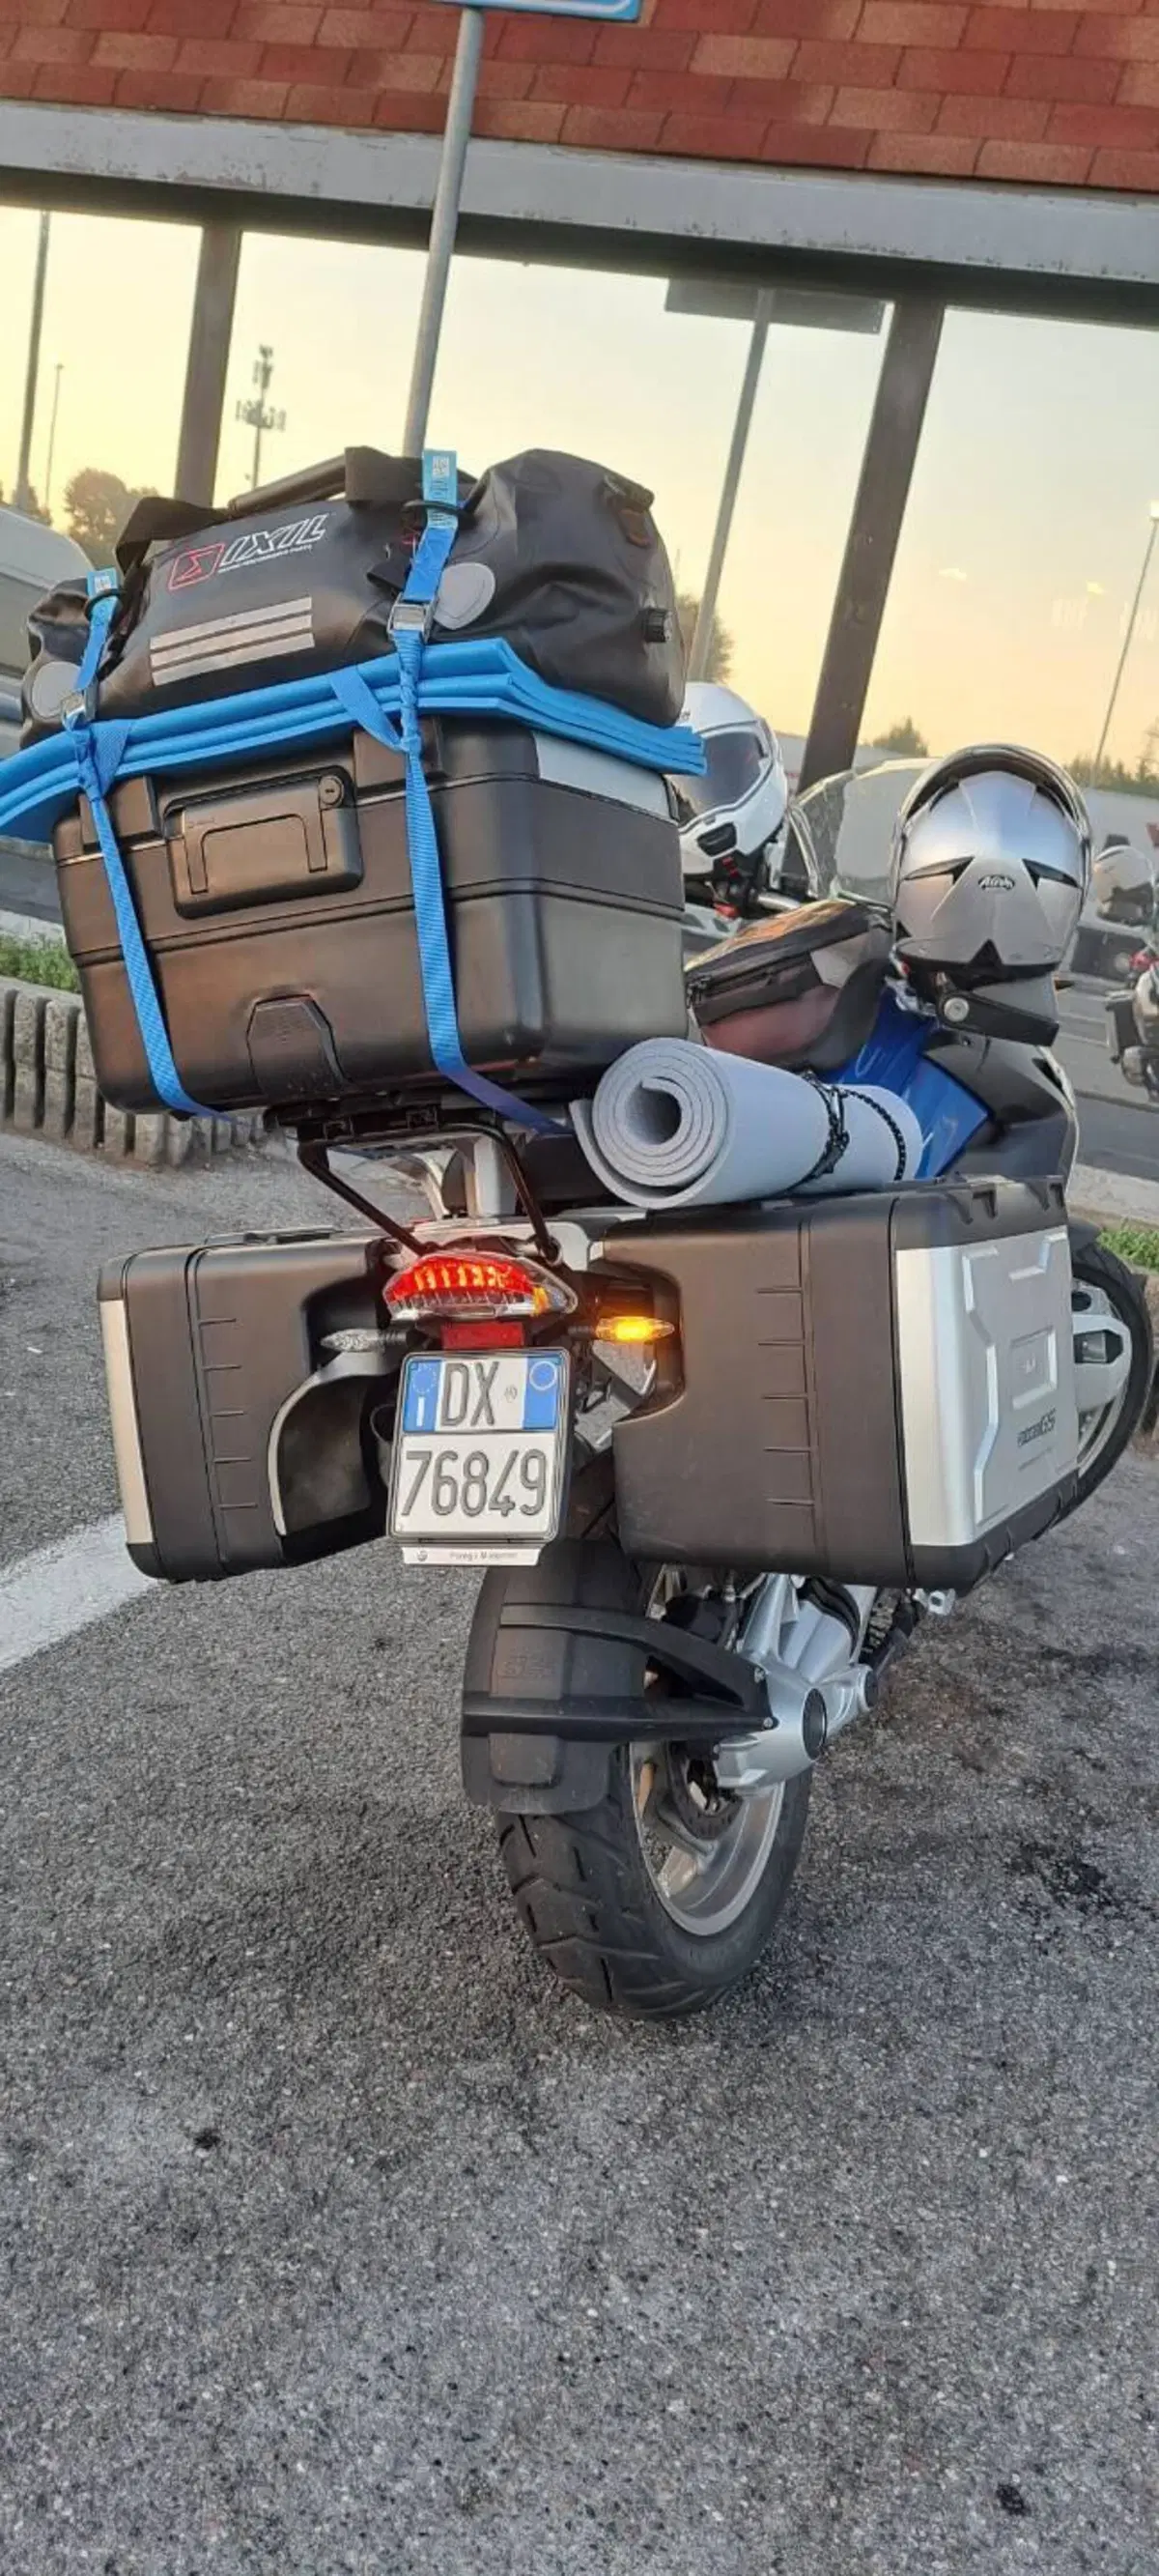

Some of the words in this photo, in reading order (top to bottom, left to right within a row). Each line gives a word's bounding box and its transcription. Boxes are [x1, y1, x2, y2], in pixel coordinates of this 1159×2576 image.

[220, 513, 329, 567] IXIL
[441, 1362, 499, 1426] DX
[401, 1449, 548, 1517] 76849
